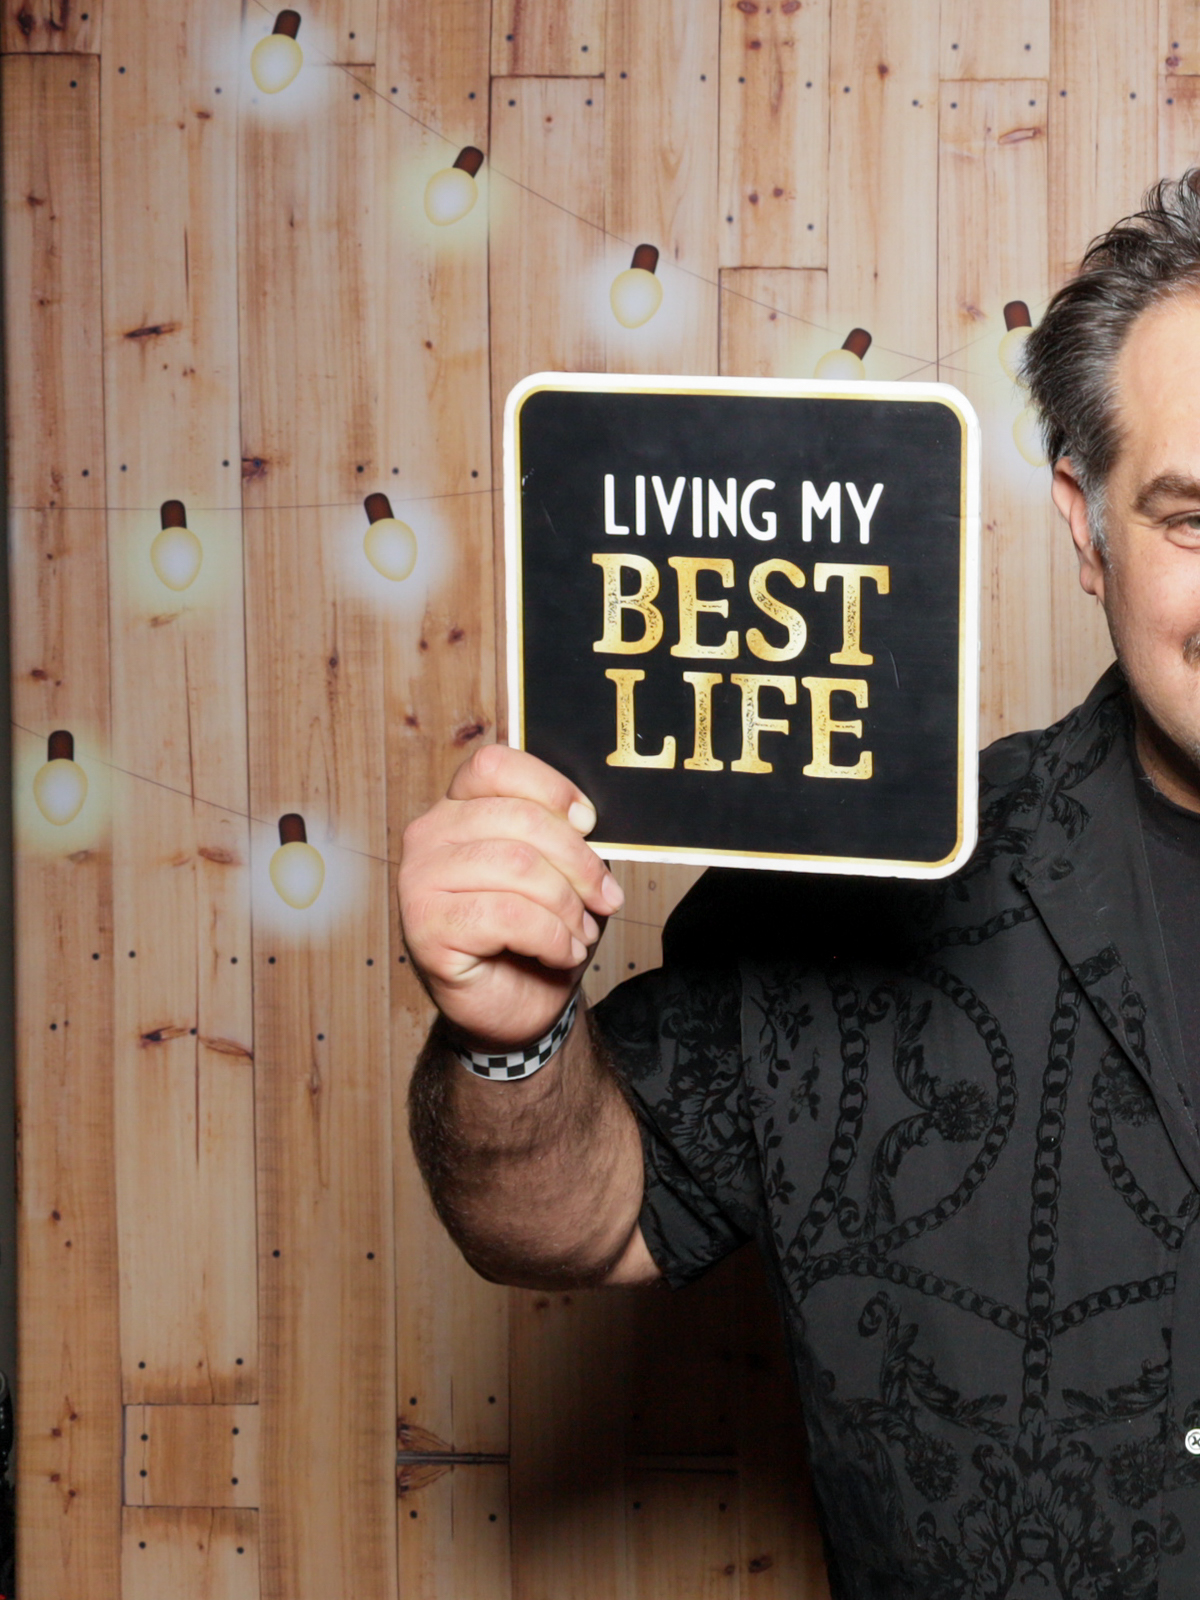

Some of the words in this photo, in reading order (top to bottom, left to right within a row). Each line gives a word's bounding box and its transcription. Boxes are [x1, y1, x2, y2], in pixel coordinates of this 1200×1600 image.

[603, 473, 778, 542] LIVING
[801, 479, 885, 545] MY
[591, 552, 890, 667] BEST
[604, 668, 873, 781] LIFE
